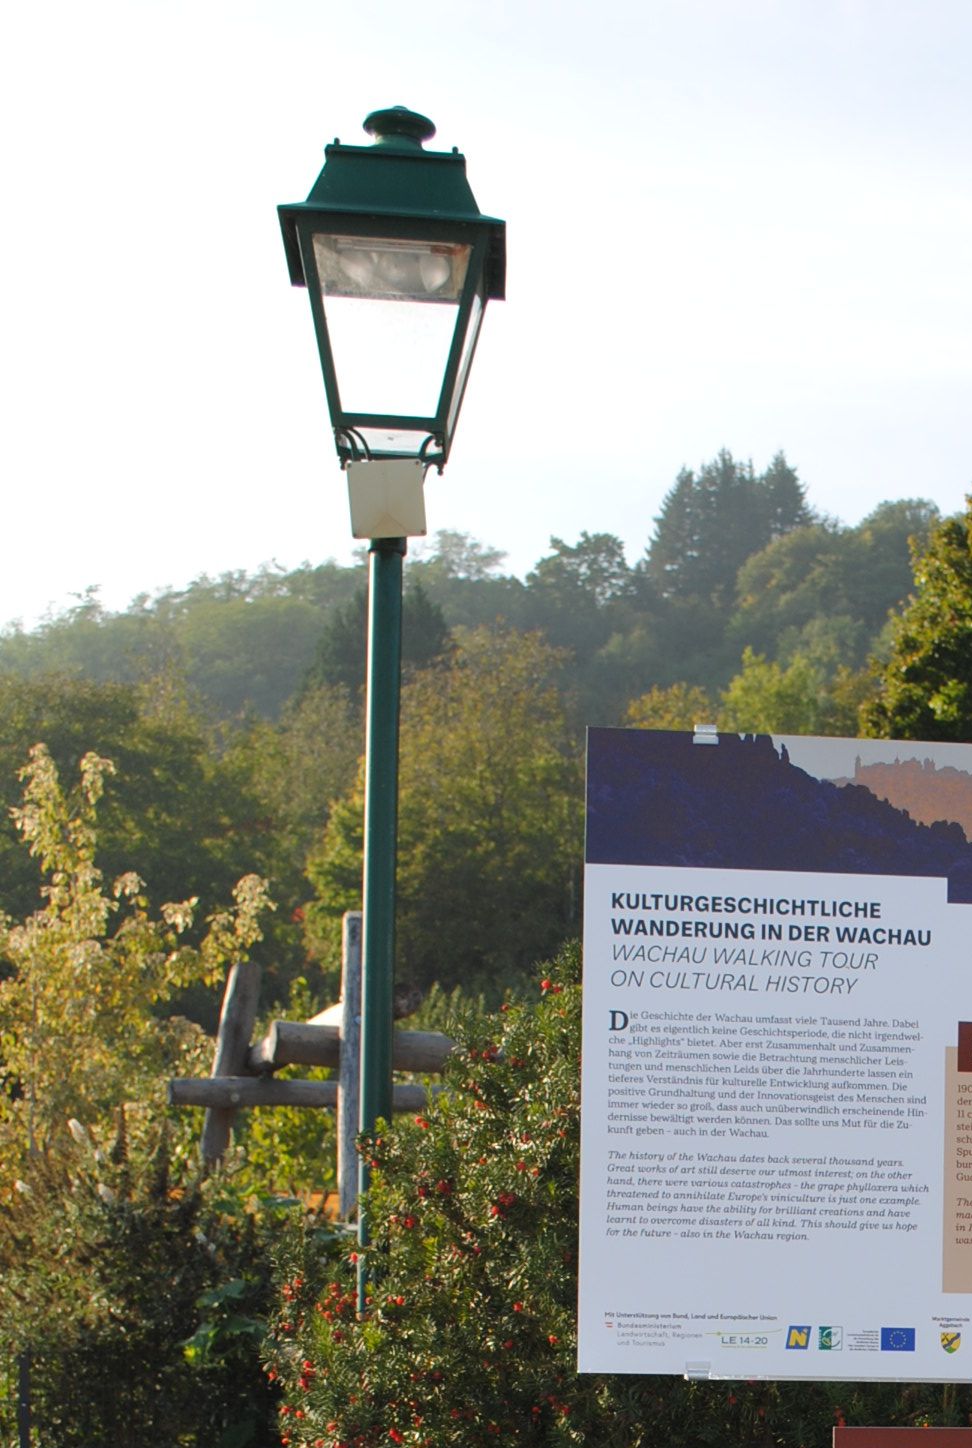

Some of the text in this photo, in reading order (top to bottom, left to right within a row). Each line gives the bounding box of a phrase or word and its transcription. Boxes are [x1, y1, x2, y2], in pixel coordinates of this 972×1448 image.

[611, 893, 880, 919] KULTURGESCHICHTLICHE
[612, 919, 931, 946] WANDERUNG IN DER WACHAU
[611, 945, 878, 970] WACHAU WALKING TOUR
[610, 970, 857, 995] ON CULTURAL HISTORY
[640, 1011, 693, 1020] Geschichte
[696, 1012, 711, 1021] der
[715, 1013, 753, 1022] Wachau
[755, 1014, 792, 1023] umfasst
[795, 1015, 817, 1024] viele
[822, 1016, 861, 1025] Tausend
[892, 1018, 919, 1027] Dabei
[608, 1061, 913, 1078] tungen und menschlichen Leids über die Jahrhunderte lassen ein
[608, 1087, 926, 1103] positive Grundhaltung und der Innovationsgeist des Menschen sind
[956, 1097, 972, 1106] der
[957, 1109, 965, 1118] 11
[721, 1337, 768, 1345] LE 14-20
